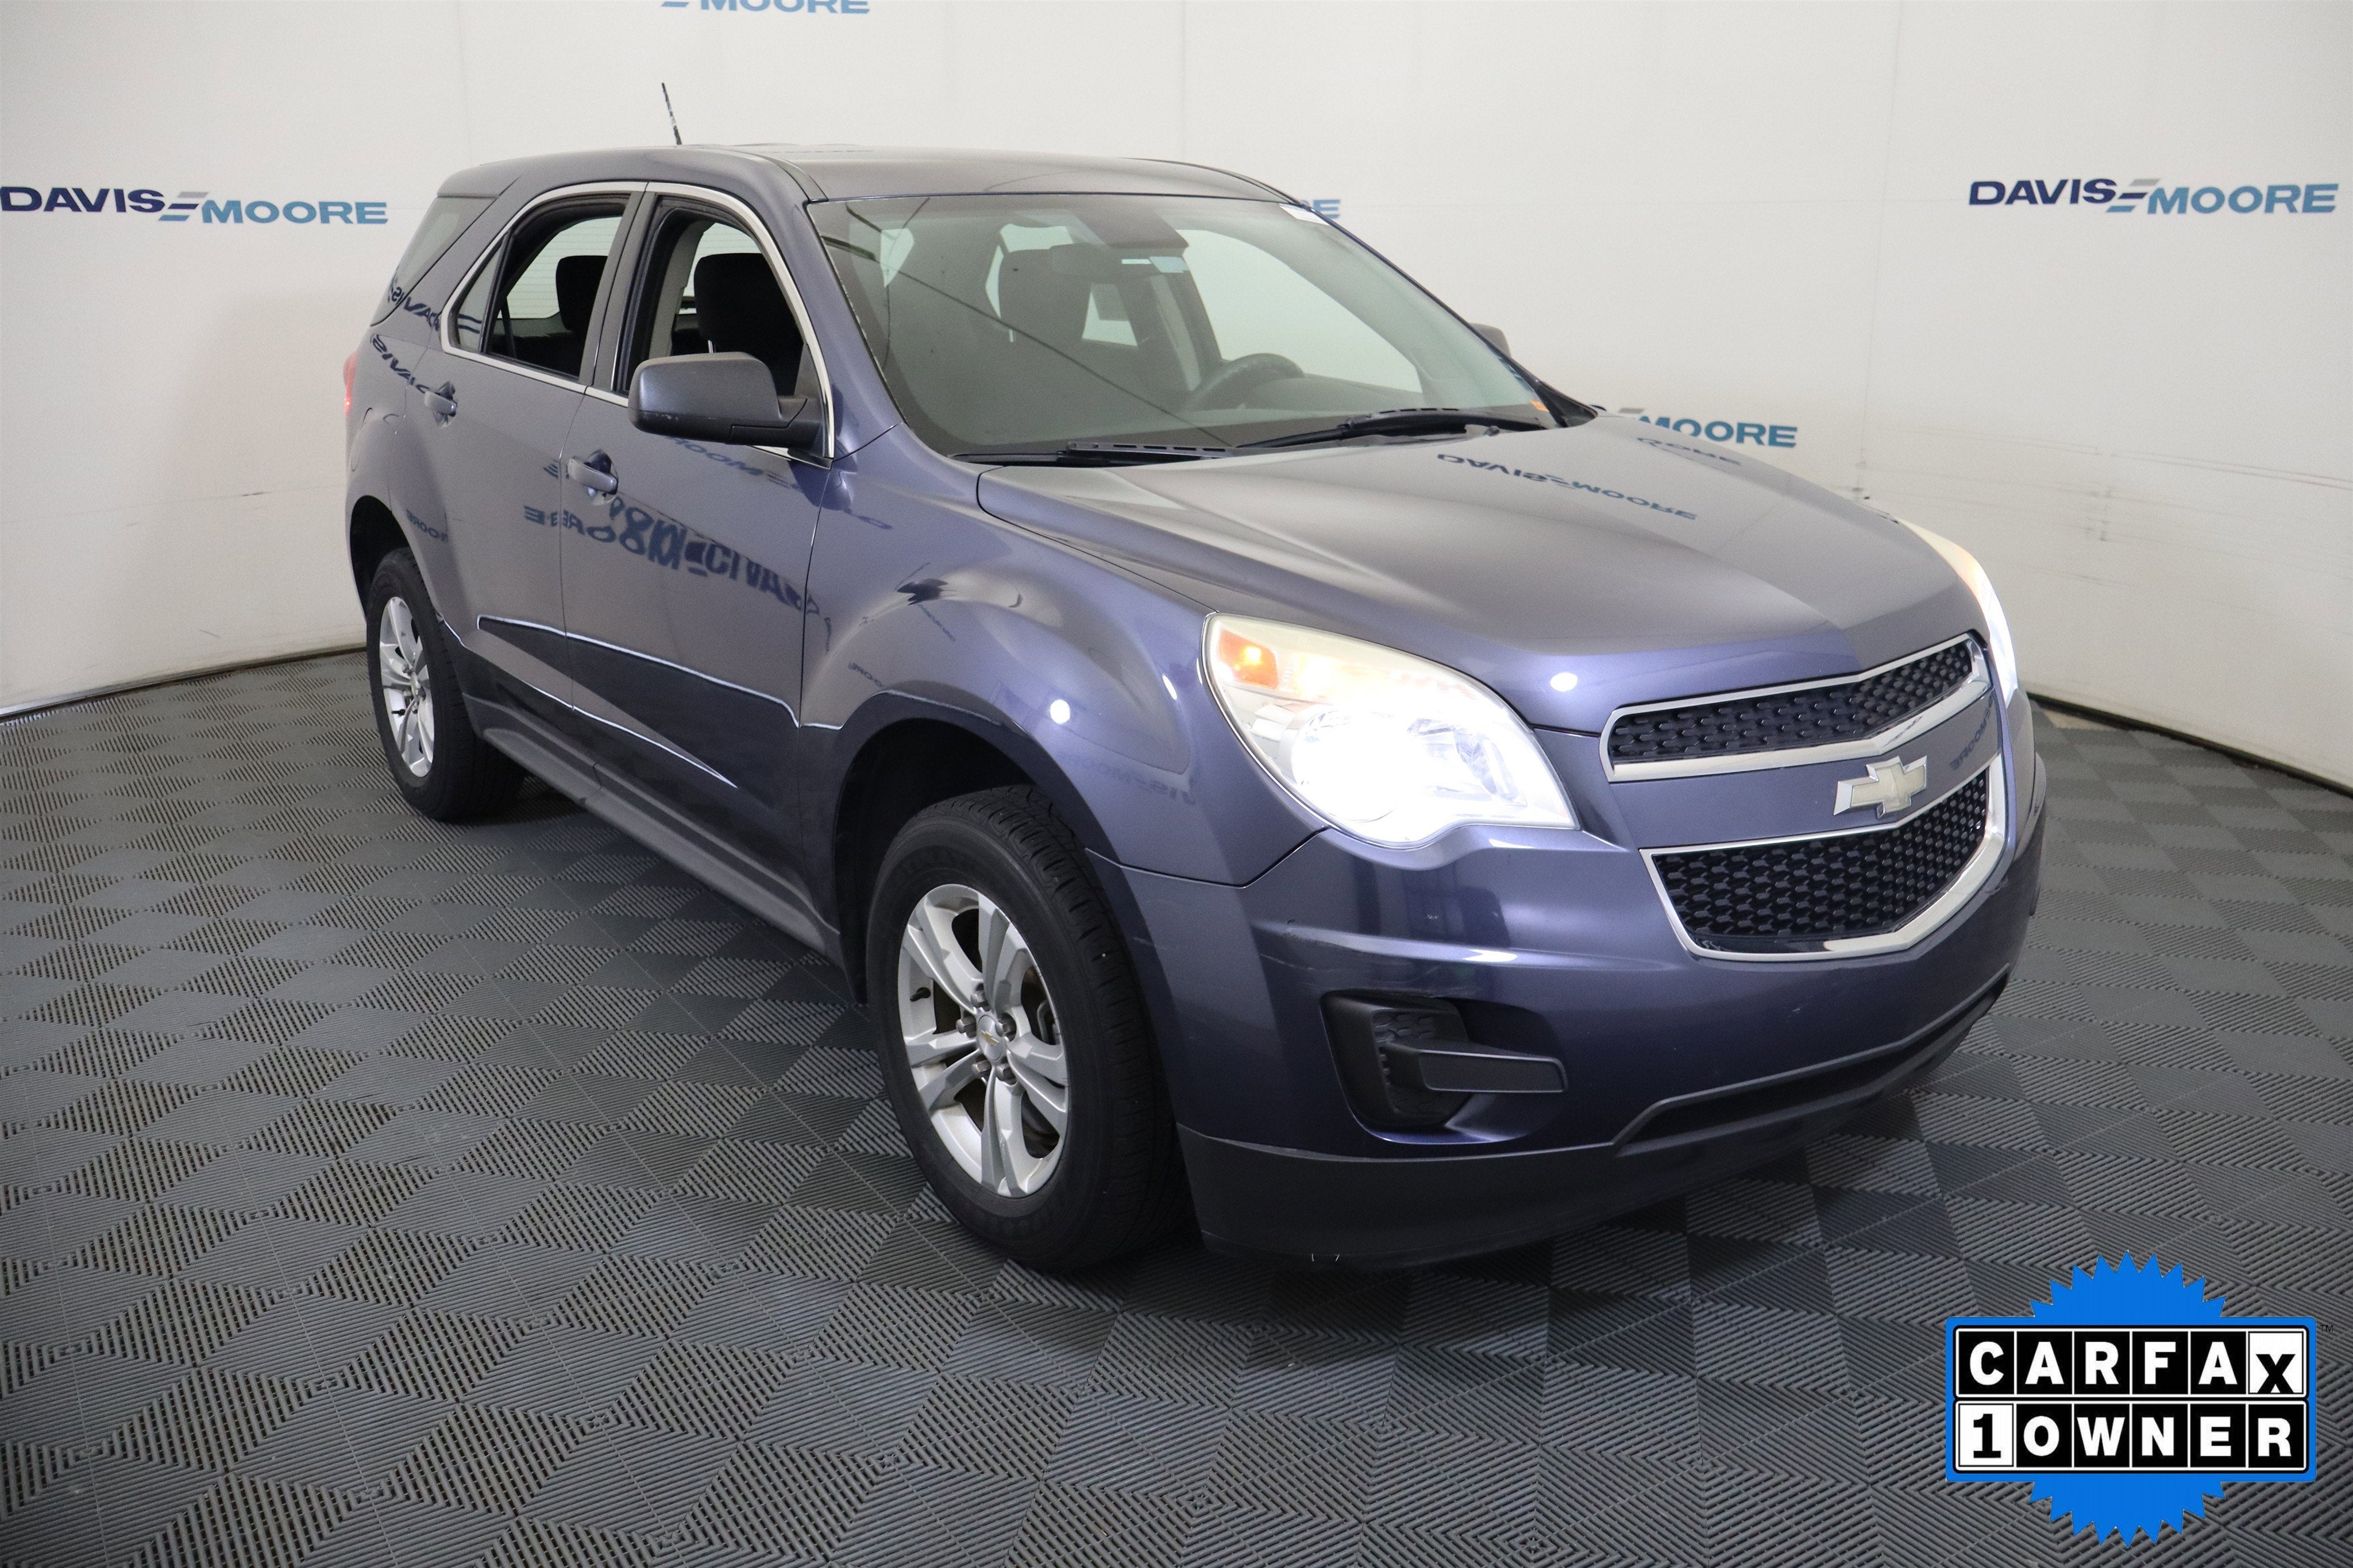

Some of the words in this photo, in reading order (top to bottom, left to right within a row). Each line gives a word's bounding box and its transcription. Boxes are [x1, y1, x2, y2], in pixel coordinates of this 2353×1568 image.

[0, 187, 165, 213] DAVIS
[201, 199, 388, 224] MOORE
[1969, 179, 2117, 206] DAVIS
[2147, 183, 2339, 214] MOORE
